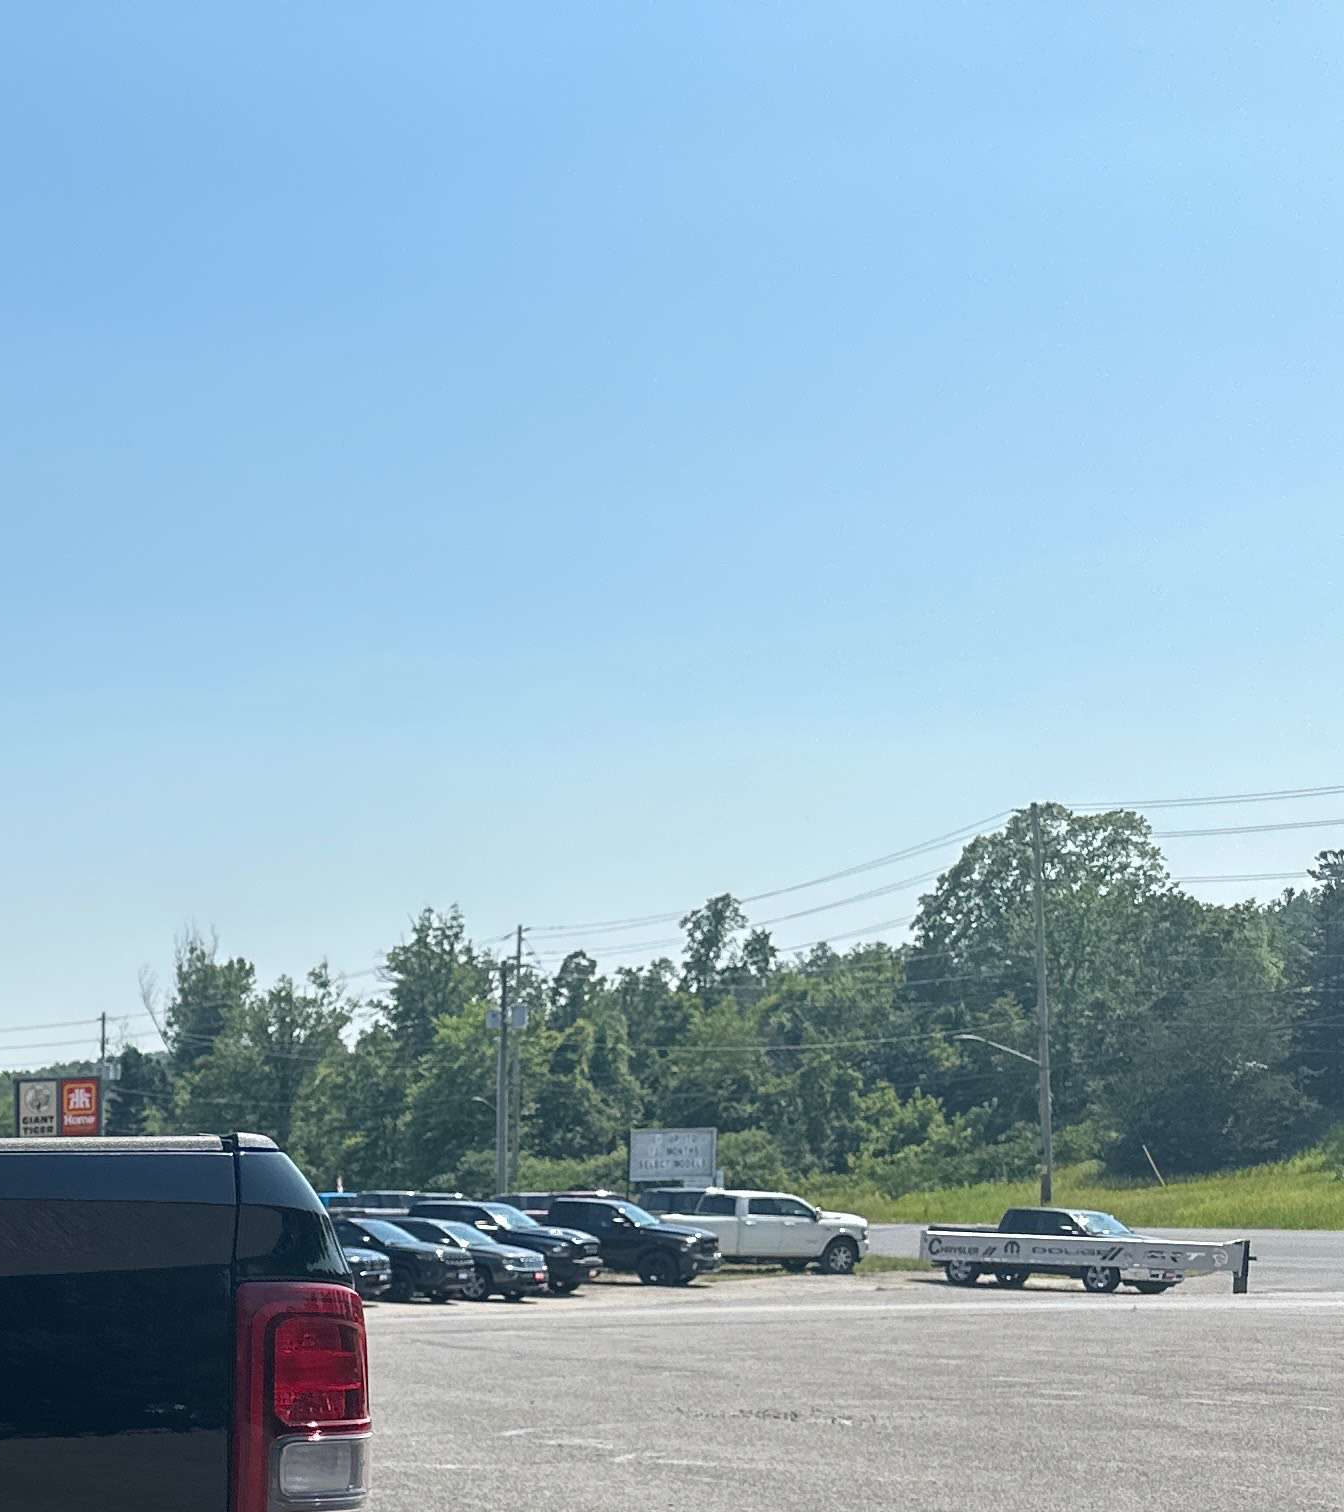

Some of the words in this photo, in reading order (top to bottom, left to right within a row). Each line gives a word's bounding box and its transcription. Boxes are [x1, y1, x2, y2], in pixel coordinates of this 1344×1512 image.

[22, 1116, 54, 1125] GIANT
[63, 1115, 96, 1126] Home
[22, 1126, 54, 1136] TIGER
[639, 1159, 671, 1169] SELECT
[673, 1159, 705, 1169] MODELS
